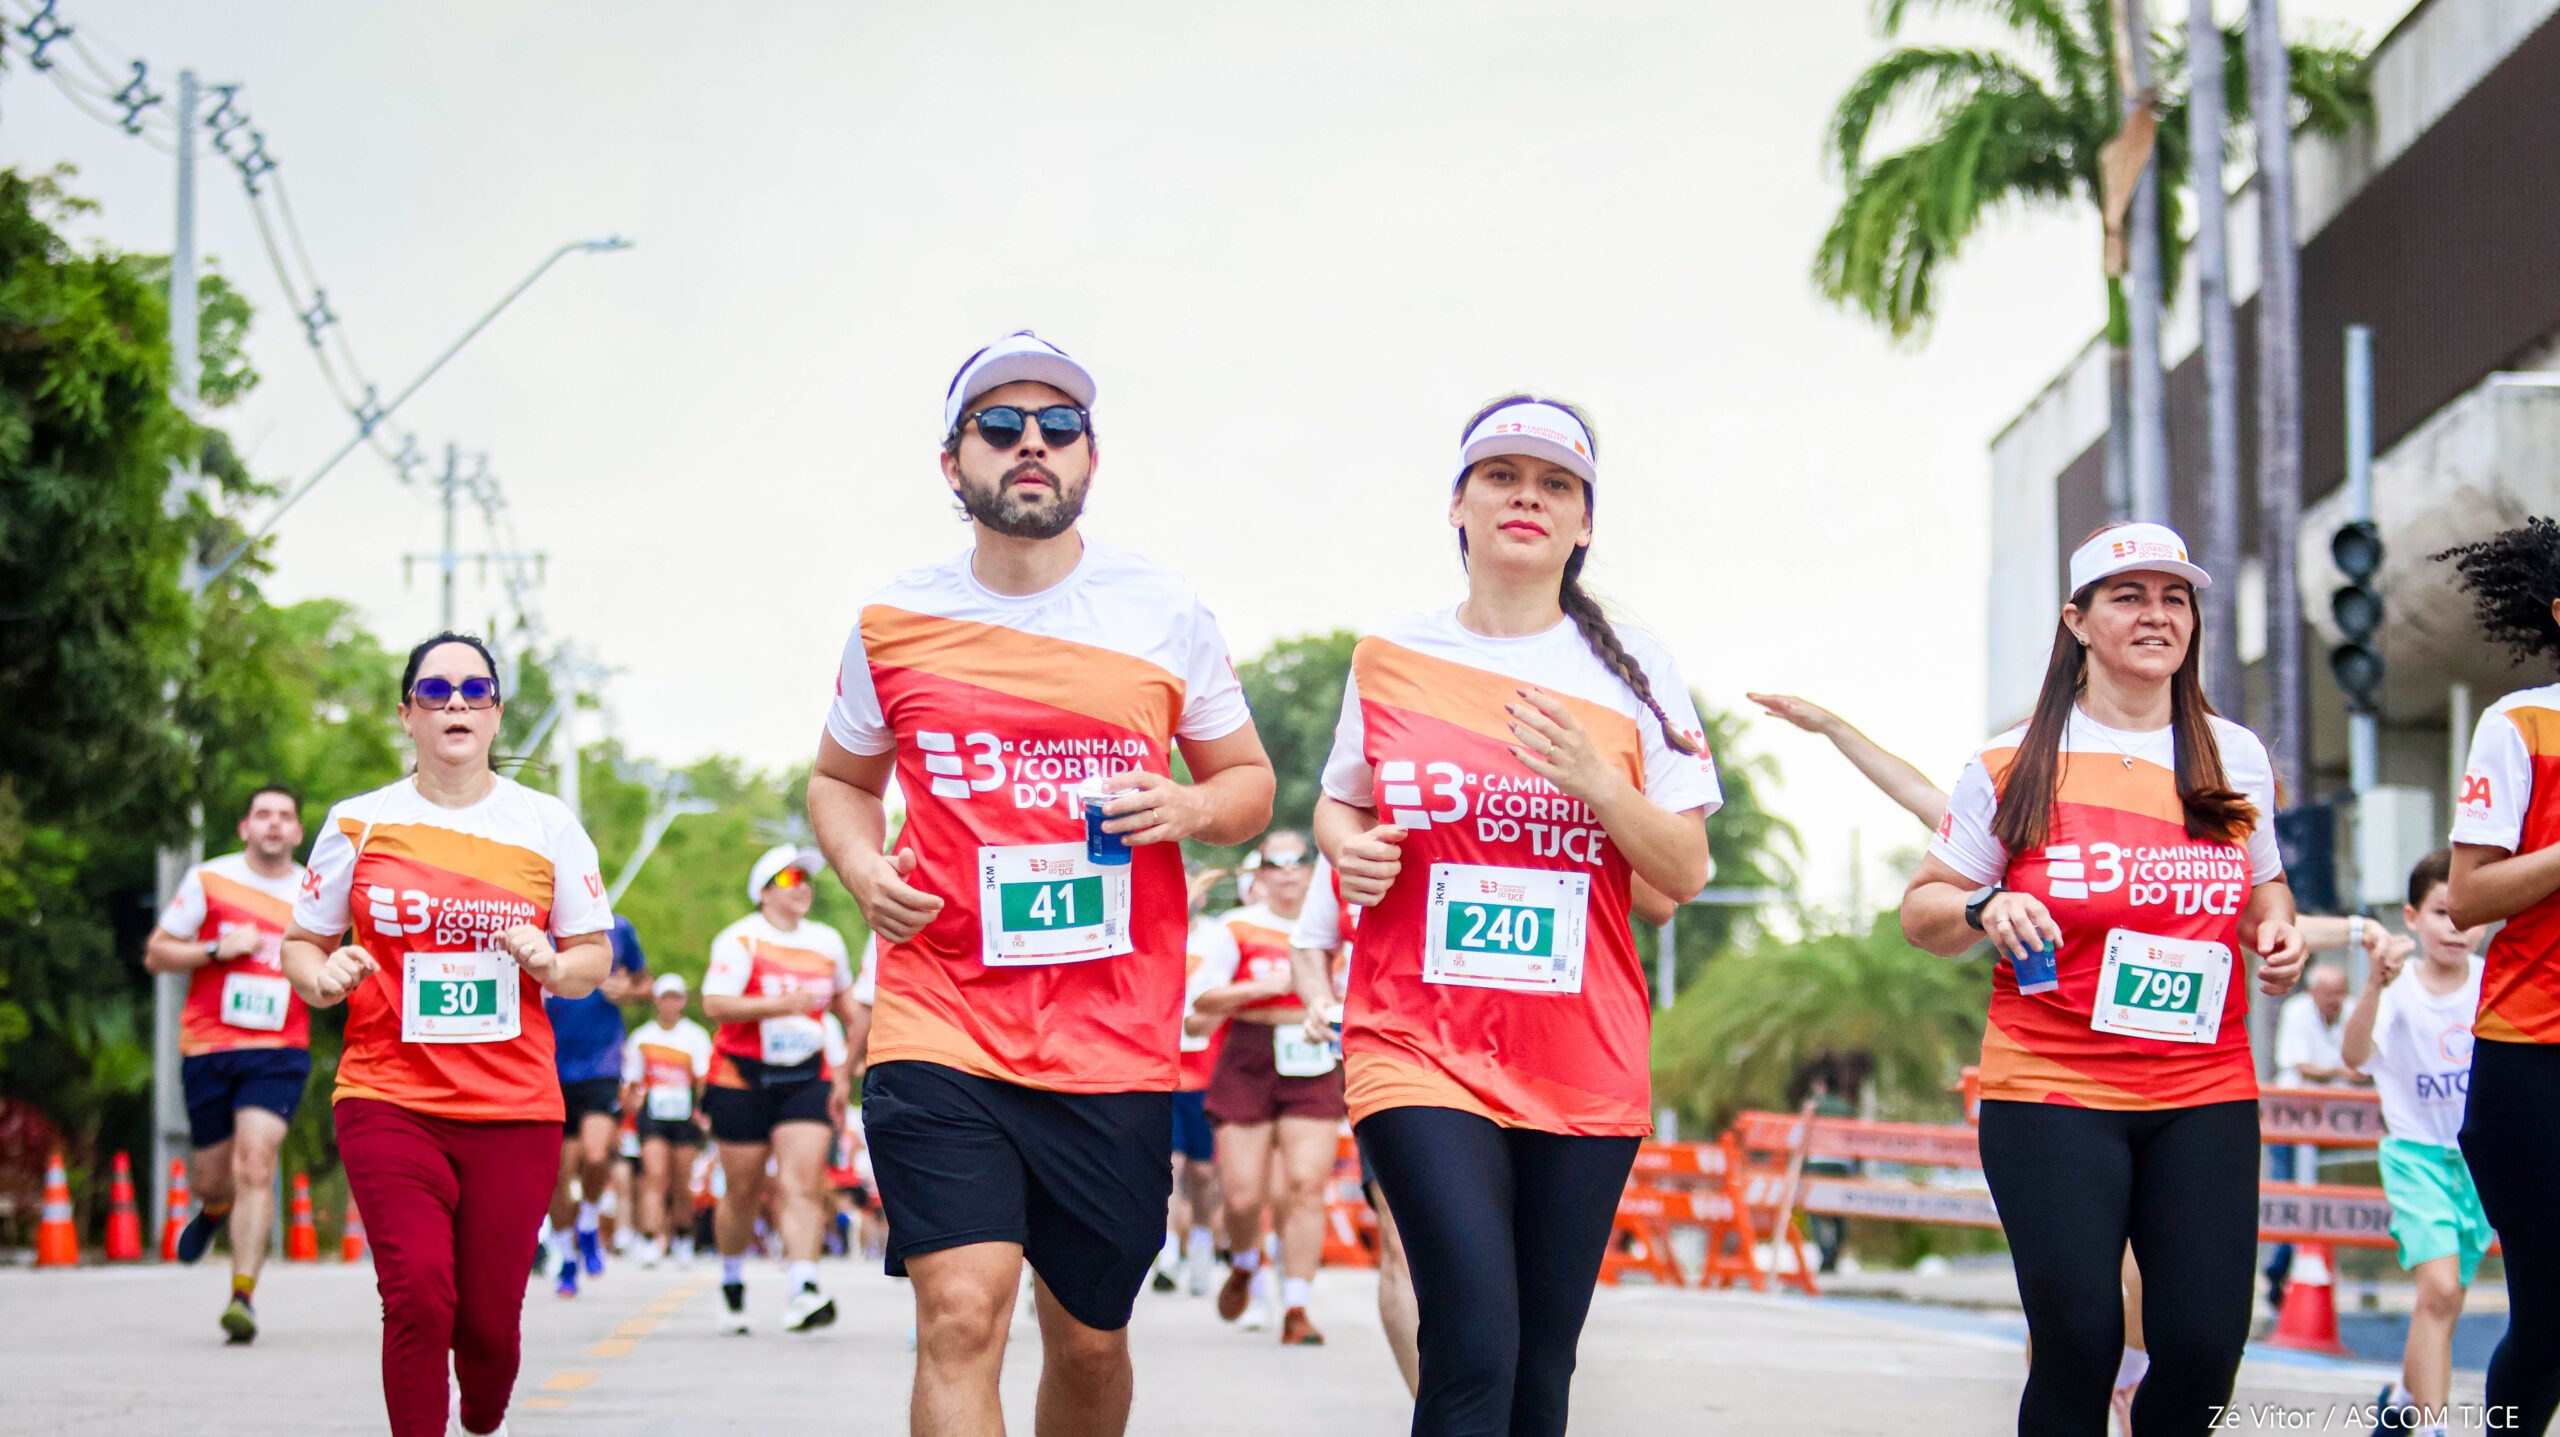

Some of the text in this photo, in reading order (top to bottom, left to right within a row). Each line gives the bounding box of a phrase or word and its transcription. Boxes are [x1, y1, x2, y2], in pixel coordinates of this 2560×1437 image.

[1020, 739, 1149, 757] CAMINHADA
[1014, 782, 1057, 809] DO
[1483, 774, 1567, 796] CAMIN
[1476, 792, 1599, 825] /CORRID
[1477, 817, 1607, 866] DO TJCE
[2136, 846, 2246, 862] CAMINHADA
[986, 866, 996, 890] 3KM
[2129, 861, 2246, 883] /CORRIDA
[1029, 883, 1075, 926] 41
[1435, 882, 1446, 906] 3KM
[2129, 882, 2243, 916] DO TJCE
[442, 897, 536, 917] CAMINHADA
[436, 928, 468, 946] DO
[1461, 905, 1539, 952] 240
[2108, 945, 2119, 967] 3KM
[440, 982, 478, 1015] 30
[2130, 967, 2192, 1010] 799
